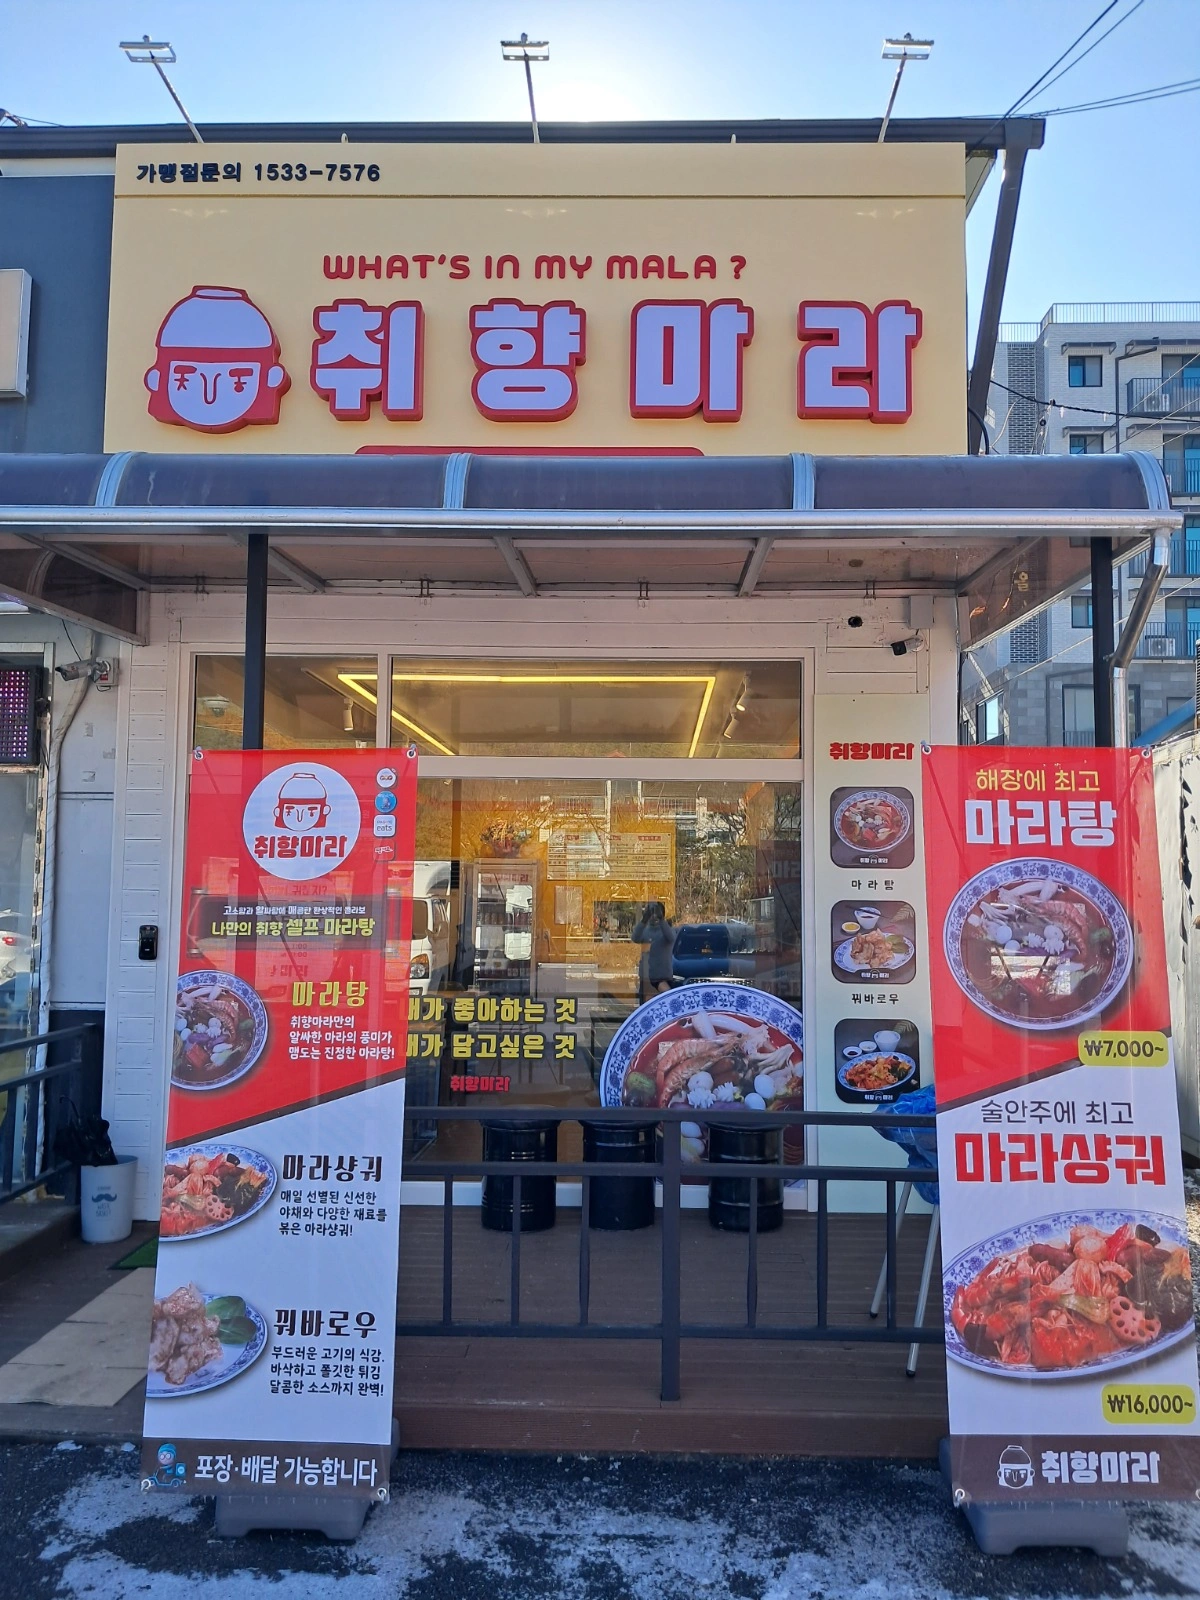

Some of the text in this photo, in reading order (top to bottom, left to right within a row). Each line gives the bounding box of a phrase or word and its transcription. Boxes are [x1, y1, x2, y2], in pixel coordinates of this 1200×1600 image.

[136, 162, 381, 183] 가맹점문의 1533-7576
[323, 255, 471, 280] WHAT'S
[485, 255, 520, 279] IN
[534, 255, 593, 279] MY
[829, 742, 915, 760] 취향마라
[975, 768, 1101, 792] 해장에 최고
[376, 824, 393, 832] eats
[964, 799, 1117, 847] 마라탕
[254, 835, 347, 859] 취향마라
[851, 879, 895, 891] 마라탕
[211, 918, 376, 937] 나만의 취향 셀프 마라탕
[292, 981, 369, 1007] 마라탕
[851, 993, 899, 1005] 꿔바로우
[453, 997, 545, 1023] 좋아하는
[555, 998, 576, 1023] 것
[290, 1015, 355, 1028] 취향마라만의
[289, 1030, 392, 1044] 알싸한 마라의 풍미가
[452, 1034, 545, 1058] 담고싶은
[555, 1035, 576, 1059] 것
[288, 1046, 395, 1060] 맴도는 진정한 마라탕!
[1083, 1040, 1164, 1058] ₩7,000~
[450, 1075, 510, 1092] 취향마라
[981, 1100, 1134, 1125] 술안주에 최고
[282, 1154, 383, 1182] 마라샹궈
[955, 1132, 1167, 1186] 마라샹궈
[280, 1189, 377, 1205] 매일 선별된 신선한
[279, 1206, 388, 1222] 야채와 다양한 재료를
[279, 1222, 353, 1237] 볶은 마라샹궈!
[274, 1309, 377, 1339] 꿔바로우
[271, 1346, 385, 1363] 부드러운 고기의 식감.
[270, 1363, 381, 1380] 바삭하고 쫄깃한 튀김
[270, 1379, 384, 1397] 달콤한 소스까지 완벽!
[1107, 1394, 1193, 1414] ₩16,000~
[284, 1457, 378, 1487] 가능합니다
[1041, 1450, 1160, 1484] 취향마라
